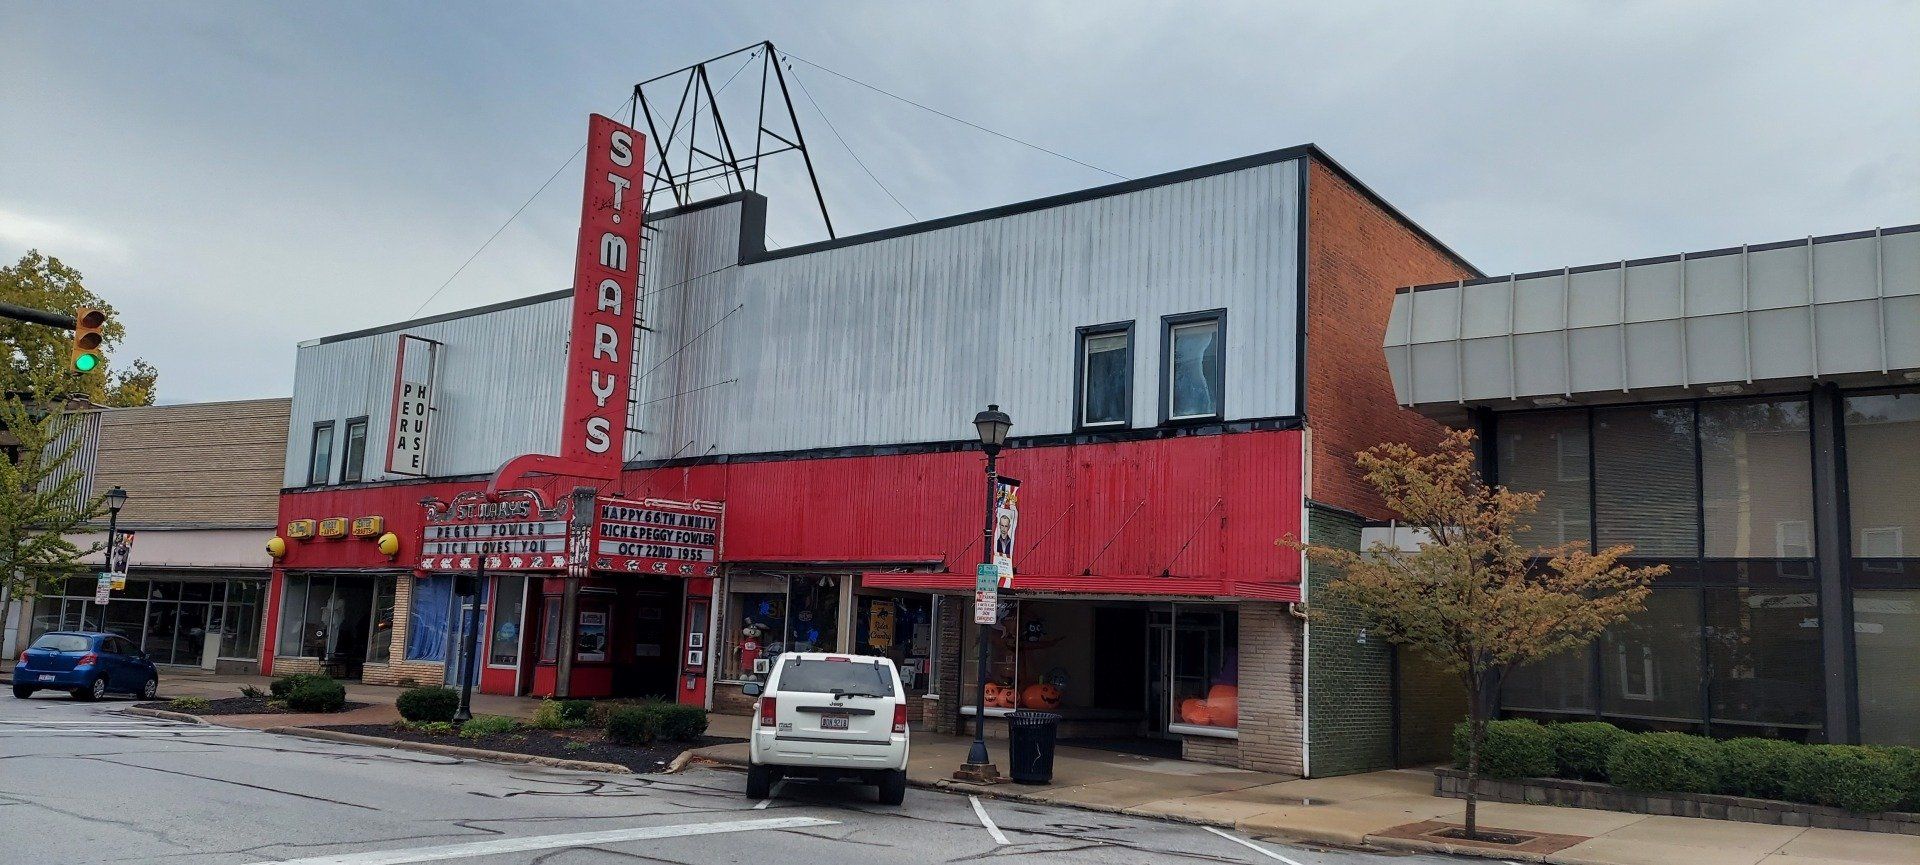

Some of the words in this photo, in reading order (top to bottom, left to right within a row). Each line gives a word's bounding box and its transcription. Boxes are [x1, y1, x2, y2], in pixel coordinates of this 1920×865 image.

[412, 386, 427, 468] HOUSE
[601, 506, 643, 522] HAPPY
[679, 514, 715, 529] ANNIV
[437, 525, 479, 538] PEGGY
[490, 523, 545, 537] FOWLER
[675, 530, 715, 545] FOWLER
[437, 541, 469, 554] RICH
[474, 541, 510, 554] LOVES
[521, 540, 546, 553] YOU
[618, 543, 644, 556] OCT
[646, 545, 673, 558] 22ND
[677, 547, 703, 561] 1955
